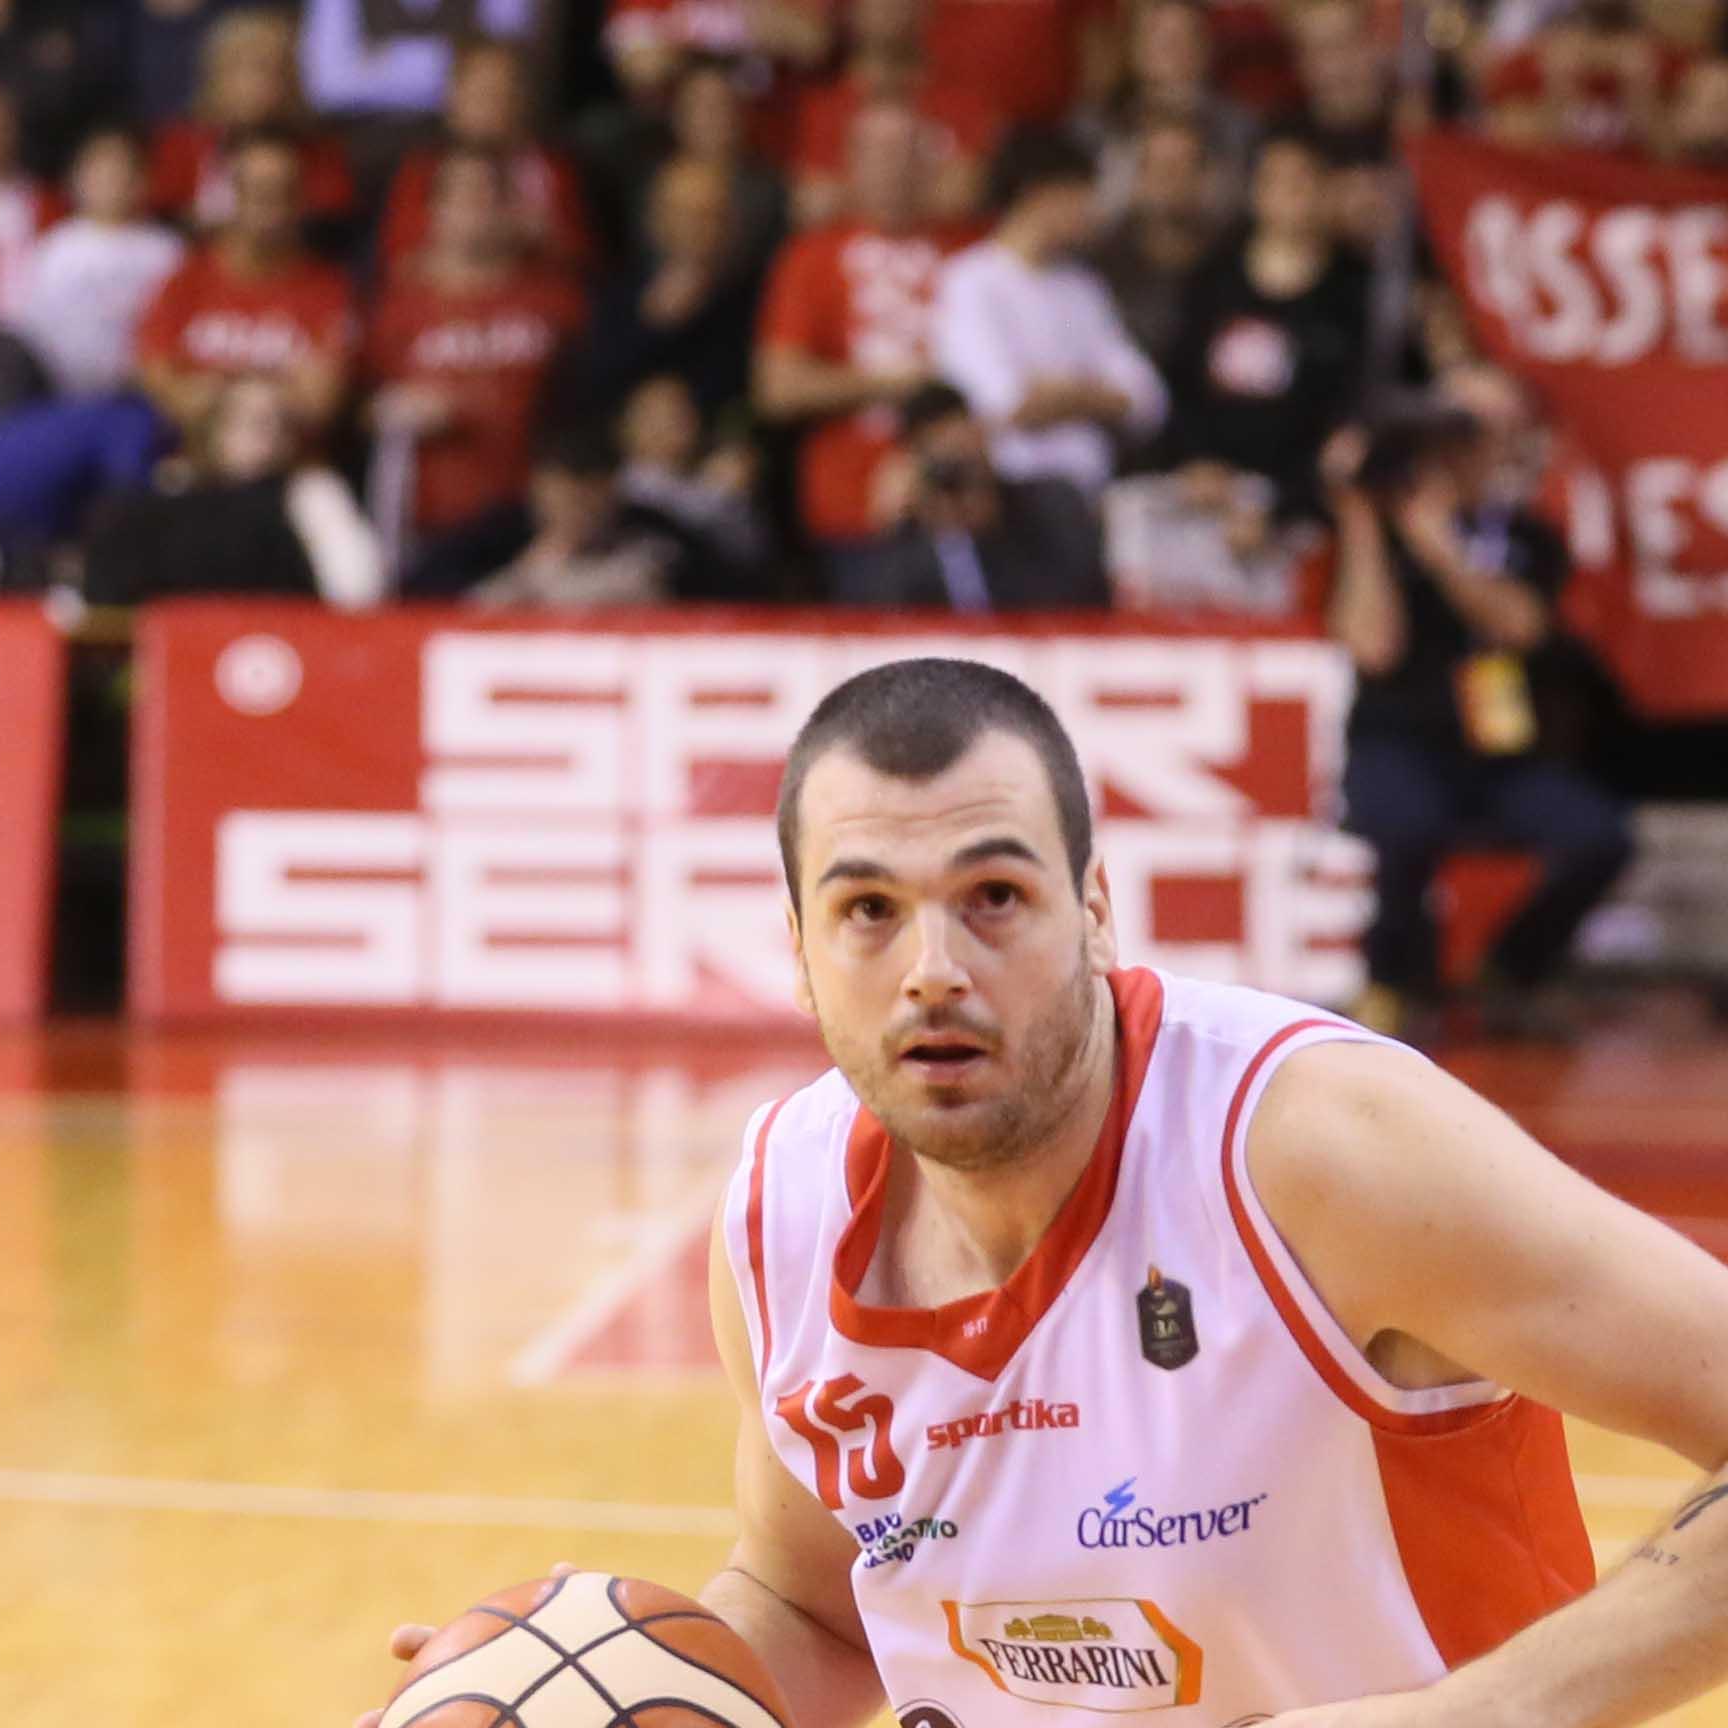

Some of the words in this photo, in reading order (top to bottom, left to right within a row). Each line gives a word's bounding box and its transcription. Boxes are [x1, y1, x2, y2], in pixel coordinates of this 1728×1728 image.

[417, 632, 1357, 820] SPRT
[775, 1371, 907, 1511] 15
[926, 1399, 1080, 1451] sportika
[1077, 1496, 1261, 1549] CarServer
[978, 1635, 1173, 1690] FERRARINI
